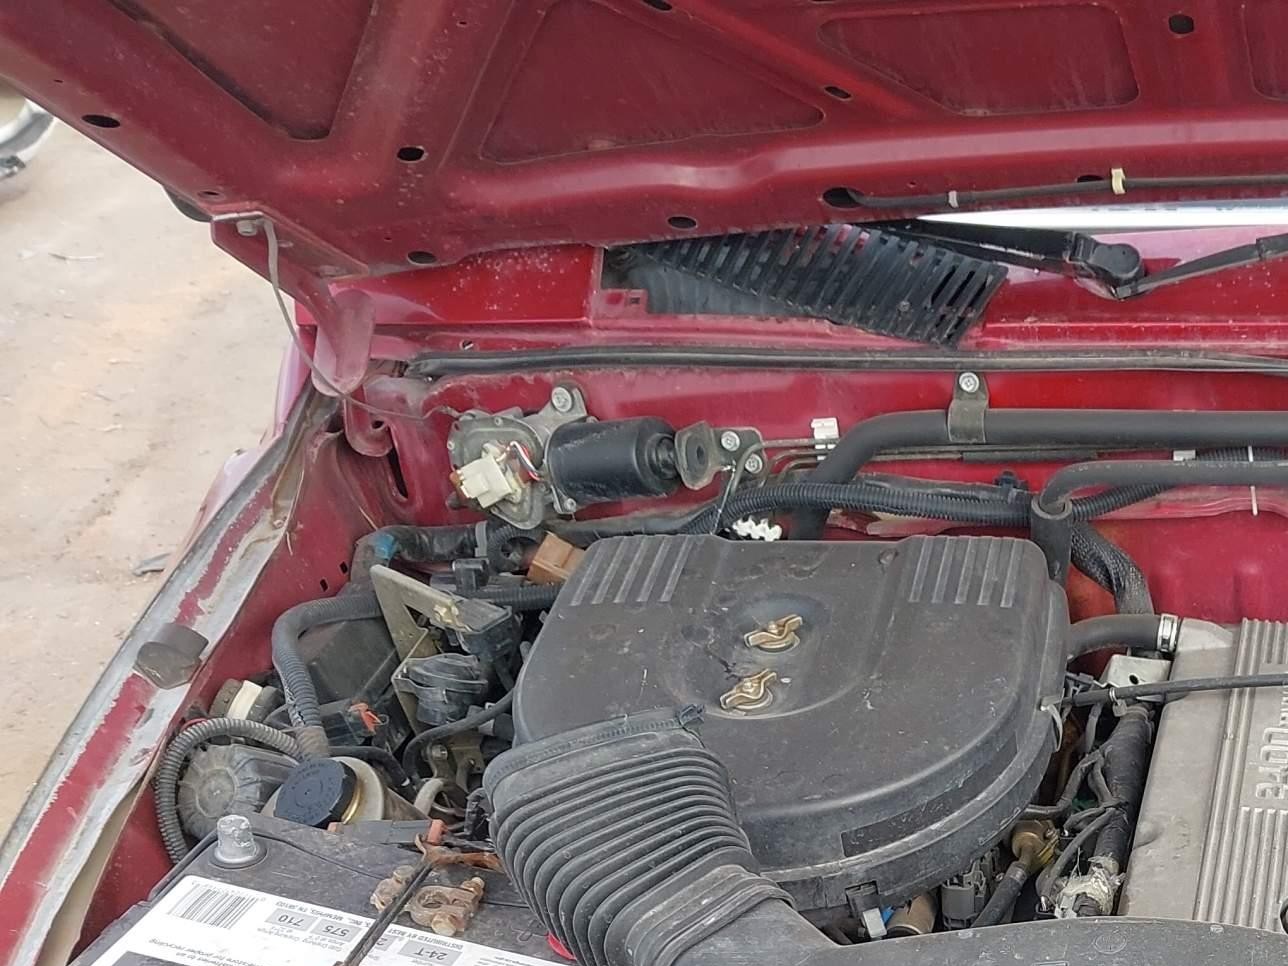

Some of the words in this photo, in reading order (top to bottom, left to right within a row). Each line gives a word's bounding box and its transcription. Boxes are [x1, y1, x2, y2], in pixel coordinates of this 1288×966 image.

[278, 913, 304, 926] 710
[322, 924, 349, 937] 575
[418, 935, 463, 949] DISTRIBUTED
[413, 946, 447, 960] 24-T
